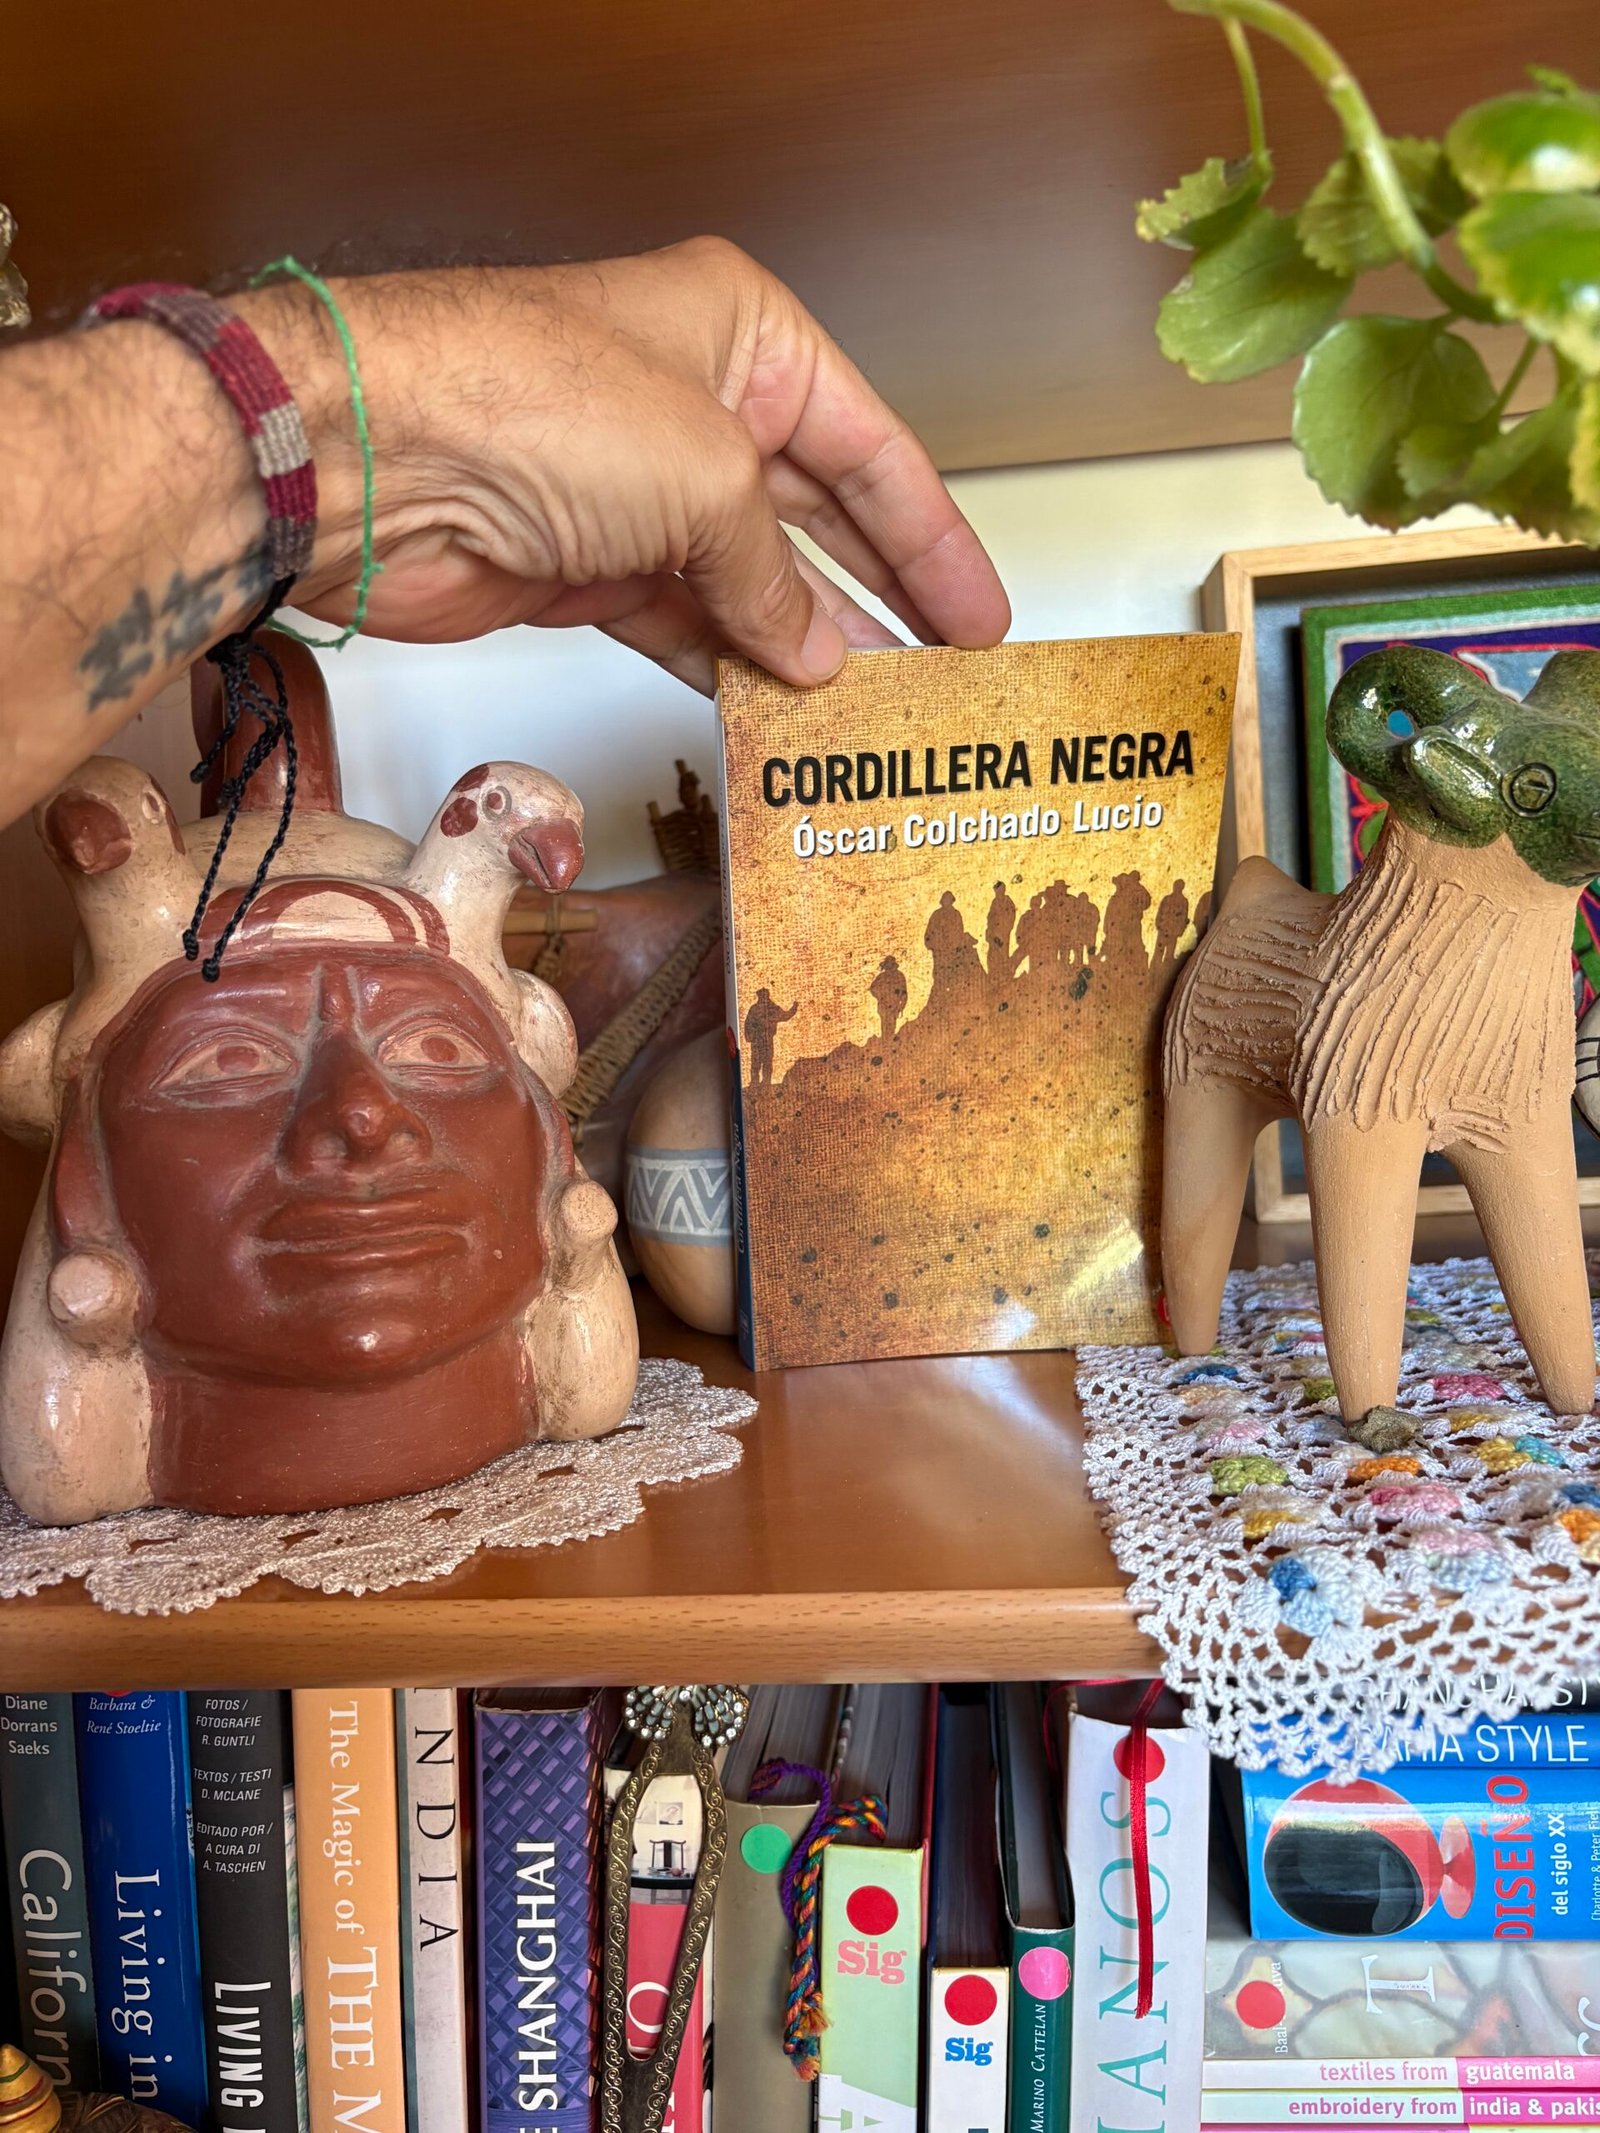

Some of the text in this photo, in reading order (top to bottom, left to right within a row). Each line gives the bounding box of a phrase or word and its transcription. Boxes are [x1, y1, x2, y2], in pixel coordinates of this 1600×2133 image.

[763, 729, 1195, 808] CORDILLERA NEGRA
[793, 795, 1164, 858] Óscar Colchado Lucio
[5, 1695, 48, 1710] Diane
[89, 1694, 156, 1711] Barbara &
[205, 1699, 241, 1711] FOTOS
[1, 1716, 58, 1733] Dorrans
[87, 1719, 162, 1735] René Stoeltie
[196, 1715, 263, 1729] FOTOGRAFIE
[328, 1700, 361, 1769] The
[8, 1740, 50, 1755] Saeks
[202, 1734, 256, 1747] R. GUNTLI
[1476, 1725, 1590, 1763] STYLE
[193, 1767, 230, 1784] TEXTOS
[239, 1768, 272, 1784] TESTI
[201, 1788, 262, 1802] D. MCLANE
[196, 1821, 238, 1838] EDITADO
[241, 1824, 266, 1837] POR
[322, 1782, 362, 1887] Magic
[414, 1688, 459, 1952] NDIA
[205, 1842, 261, 1855] A CURA DI
[1480, 1774, 1537, 1940] DISEÑO
[1589, 1833, 1600, 1861] Peter
[202, 1860, 267, 1874] A. TASCHEN
[1548, 1812, 1573, 1916] del siglo XX
[1590, 1875, 1600, 1921] Charlotte
[335, 1899, 366, 1935] of
[516, 1842, 559, 2111] SHANGHAI
[836, 1939, 908, 1985] Sig
[111, 1868, 173, 2101] Living in
[327, 1945, 381, 2071] THE
[214, 1981, 272, 2108] LIVING
[944, 2037, 994, 2067] Sig
[1029, 2003, 1047, 2133] MARINO CATTELAN
[1319, 2059, 1576, 2085] textiles from guatemala
[1288, 2097, 1405, 2119] embroidery
[1410, 2097, 1457, 2115] from
[1469, 2096, 1521, 2116] india
[1527, 2098, 1545, 2116] &
